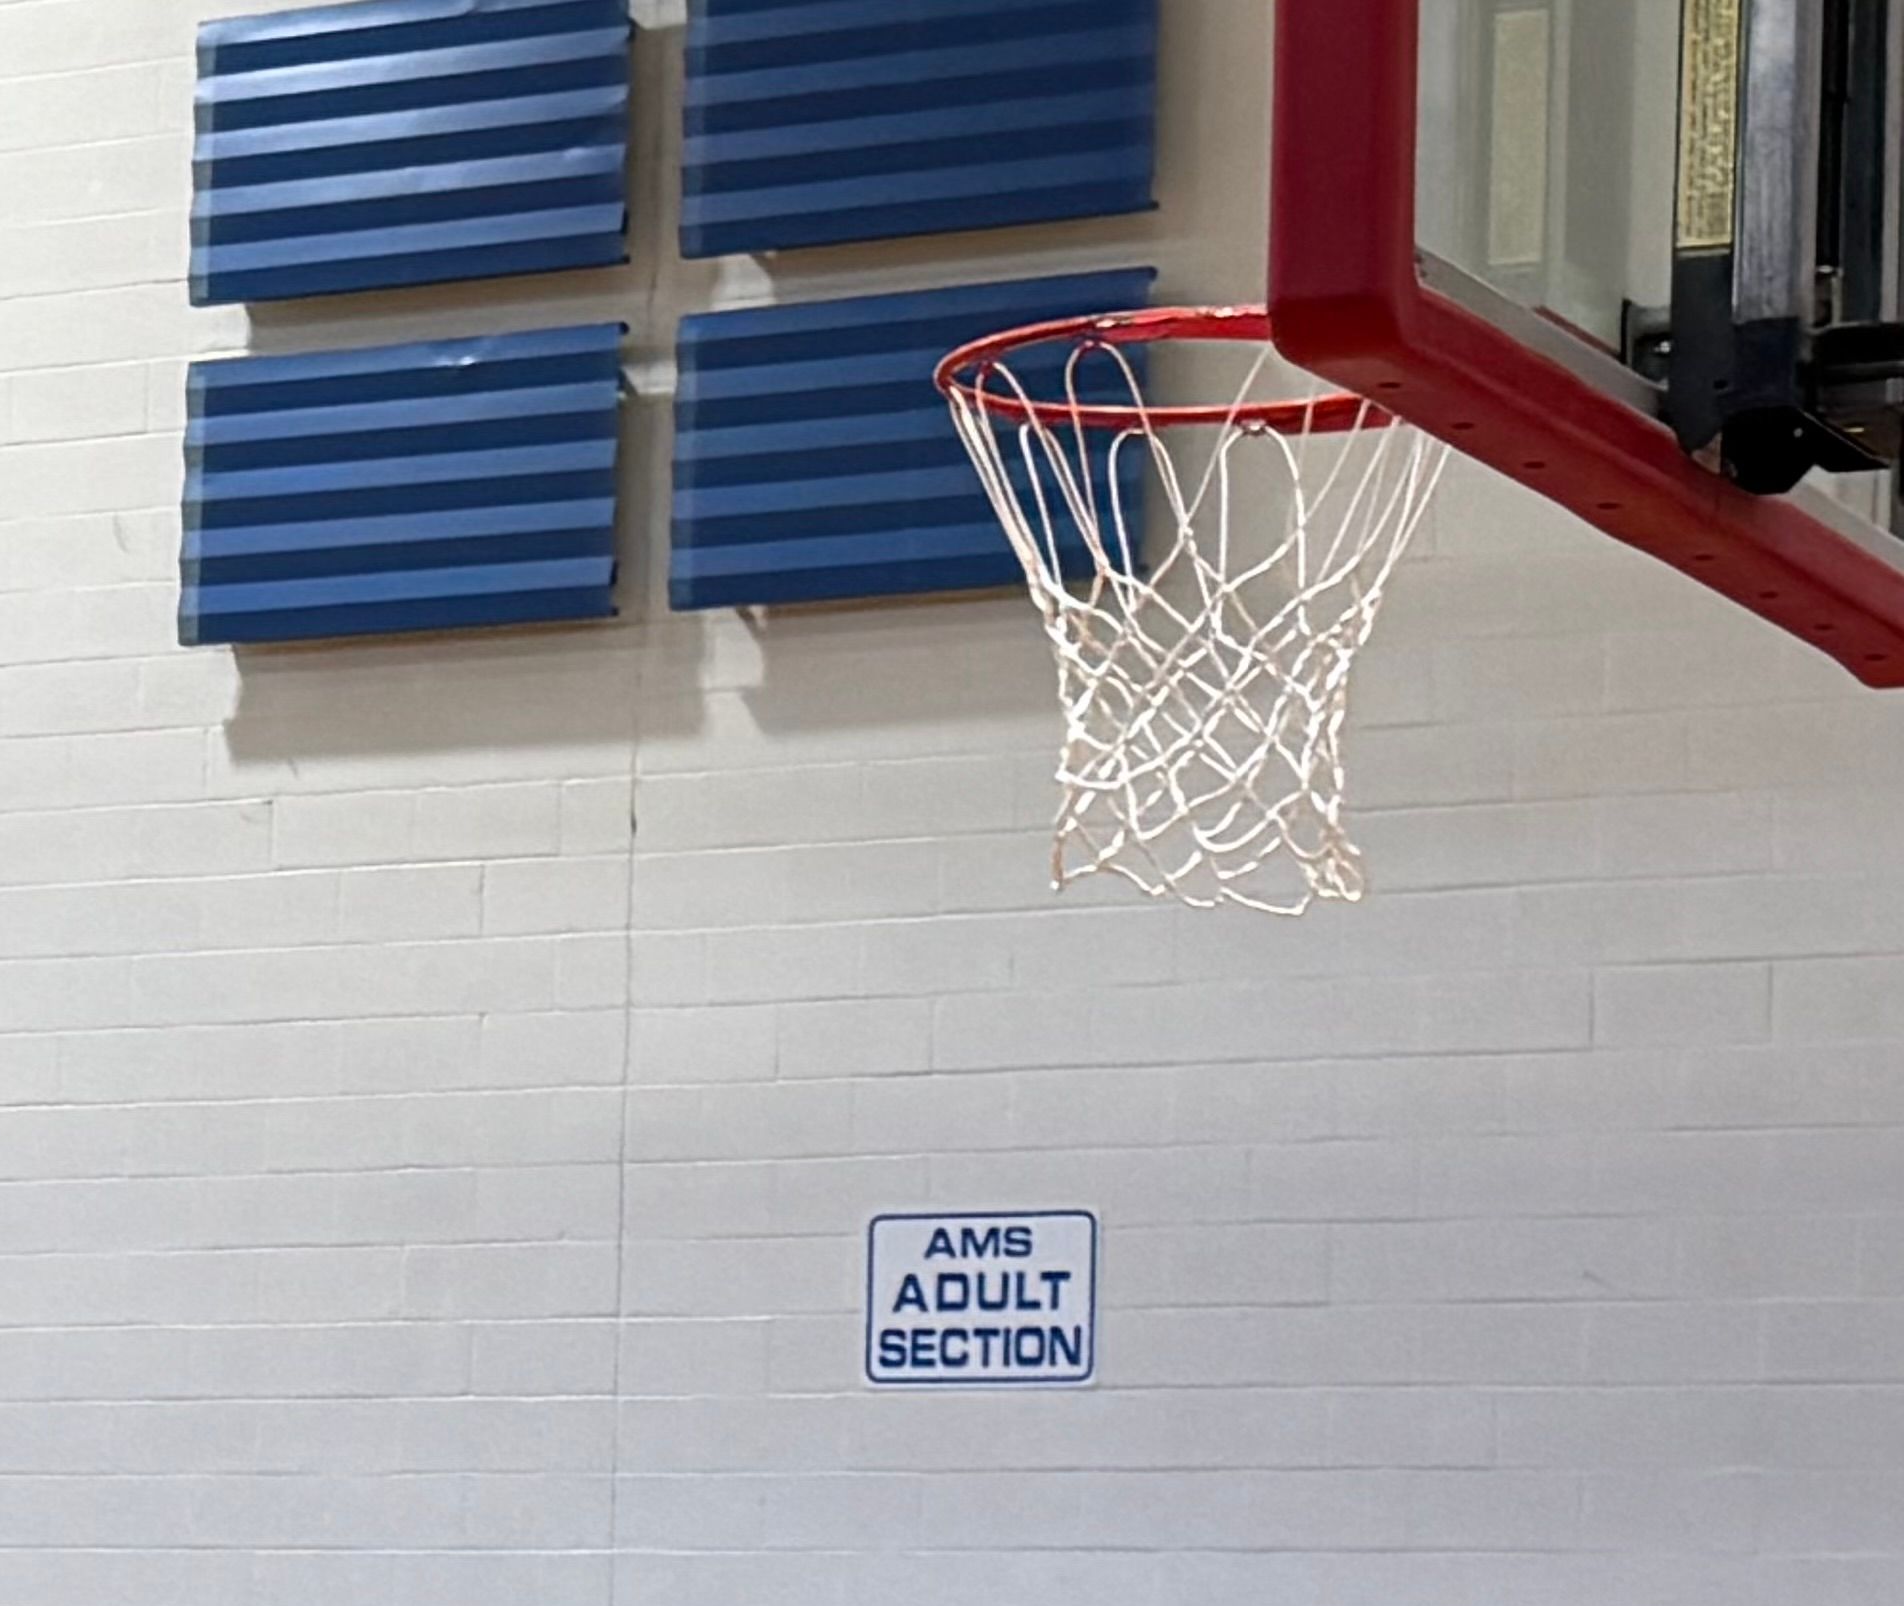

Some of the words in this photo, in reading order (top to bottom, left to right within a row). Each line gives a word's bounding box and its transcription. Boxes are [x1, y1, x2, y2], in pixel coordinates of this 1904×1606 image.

[924, 1226, 1033, 1259] AMS
[892, 1270, 1071, 1313] ADULT
[878, 1324, 1081, 1368] SECTION
